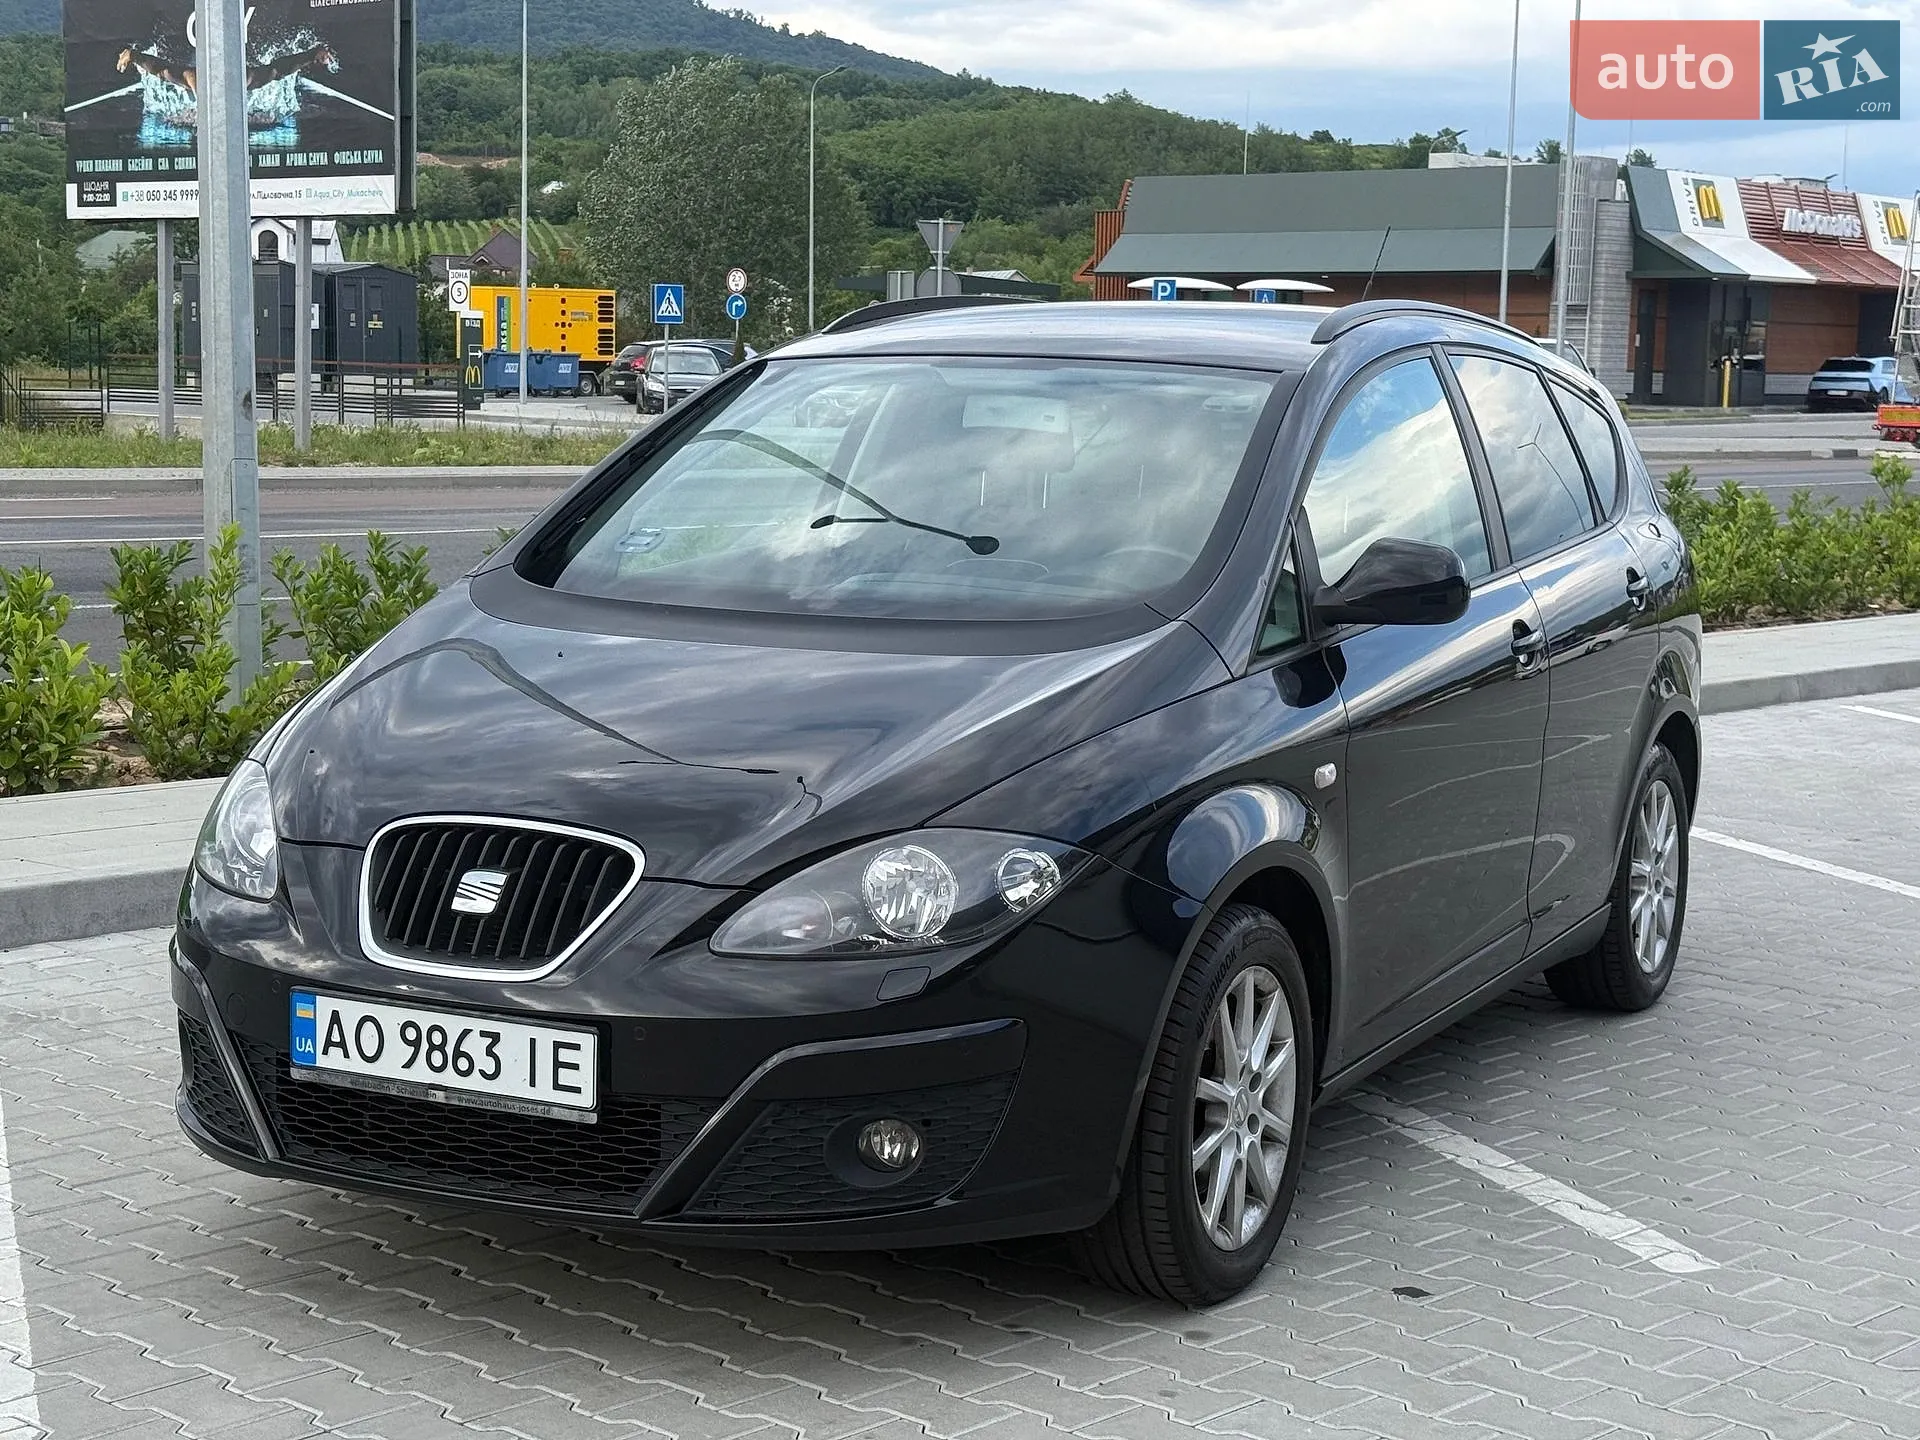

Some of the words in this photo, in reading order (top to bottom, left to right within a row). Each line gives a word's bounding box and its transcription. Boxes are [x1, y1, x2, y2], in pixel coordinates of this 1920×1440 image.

[83, 181, 110, 192] ЩОДНЯ
[130, 191, 144, 202] +38
[146, 190, 161, 202] 050
[163, 189, 178, 201] 345
[180, 189, 199, 201] 9999
[1681, 177, 1699, 227] DRIVE
[1872, 199, 1890, 246] DRIVE
[1157, 282, 1172, 301] P
[295, 1036, 315, 1054] UA
[321, 1009, 385, 1064] AO
[399, 1020, 502, 1081] 9863
[528, 1037, 582, 1094] IE
